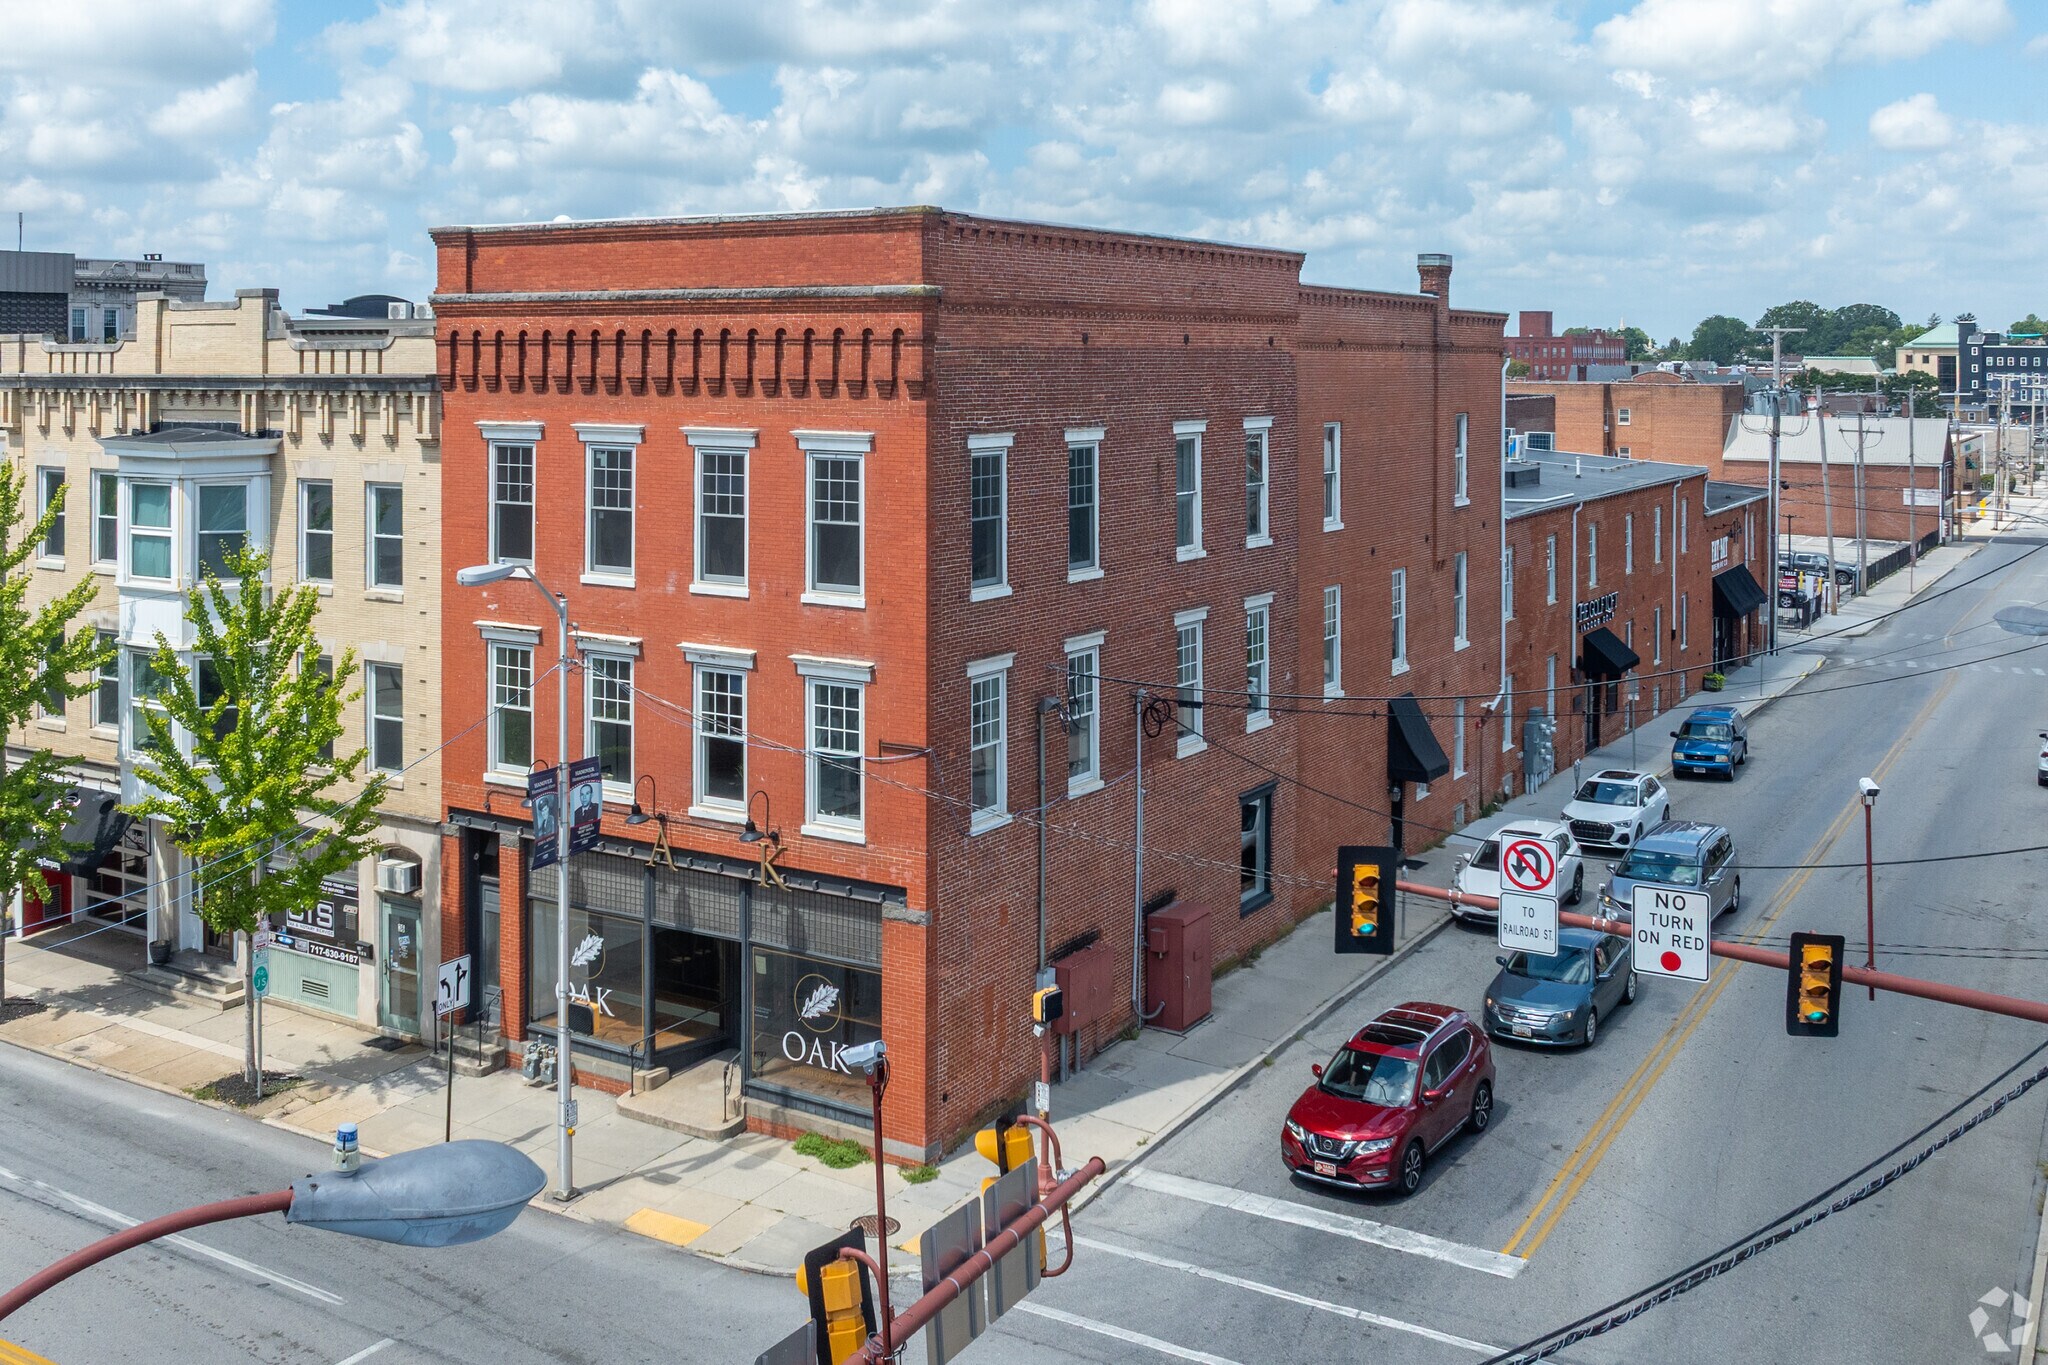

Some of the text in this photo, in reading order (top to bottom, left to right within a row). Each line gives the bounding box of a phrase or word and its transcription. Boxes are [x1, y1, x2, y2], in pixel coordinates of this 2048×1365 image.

[1590, 596, 1606, 618] GOLF
[575, 767, 595, 776] HANOVER
[534, 778, 553, 789] HANOVER
[1655, 893, 1686, 911] NO
[1522, 907, 1536, 918] TO
[1649, 912, 1694, 931] TURN
[316, 928, 334, 936] SERVICE
[1502, 923, 1554, 942] RAILROAD ST.
[1638, 930, 1705, 951] ON RED
[310, 945, 358, 964] 717-630-9187
[438, 998, 454, 1010] ONLY
[782, 1031, 852, 1075] OAK
